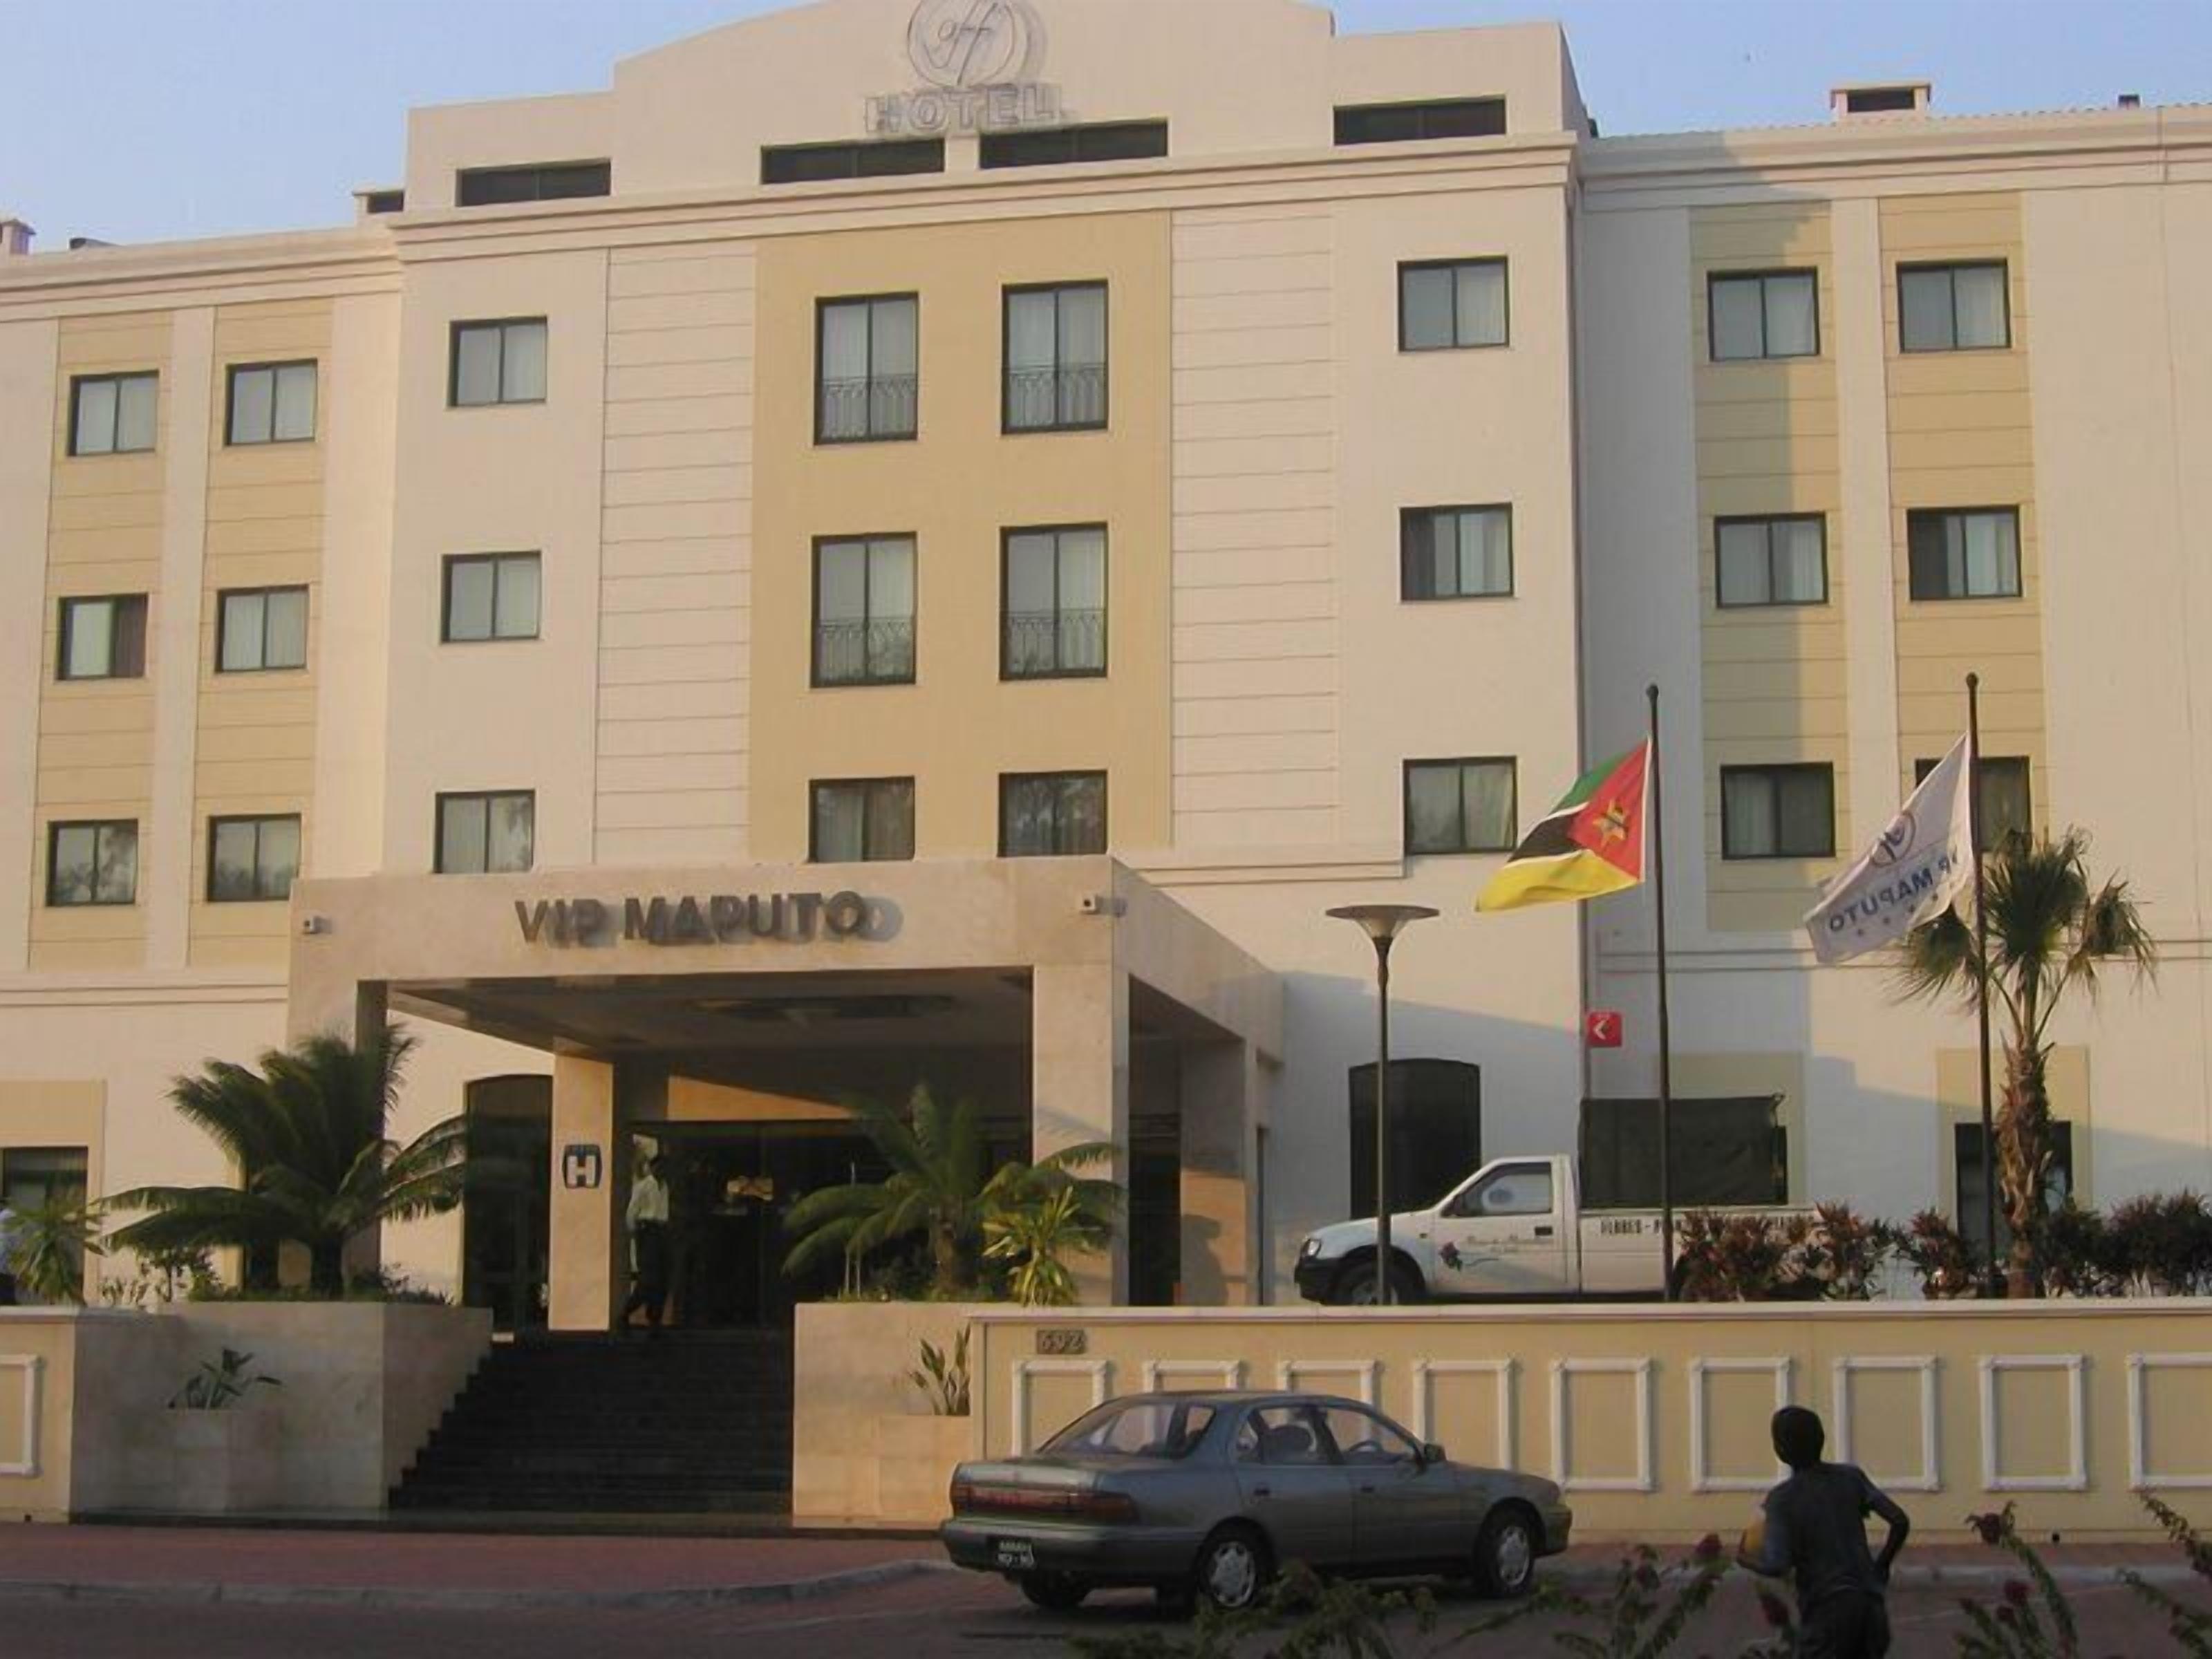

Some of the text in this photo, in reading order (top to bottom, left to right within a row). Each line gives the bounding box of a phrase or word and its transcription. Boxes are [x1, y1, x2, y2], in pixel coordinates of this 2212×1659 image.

[864, 83, 1061, 132] HOTEL
[515, 890, 867, 946] VIP MAPUTO
[568, 1155, 596, 1187] H
